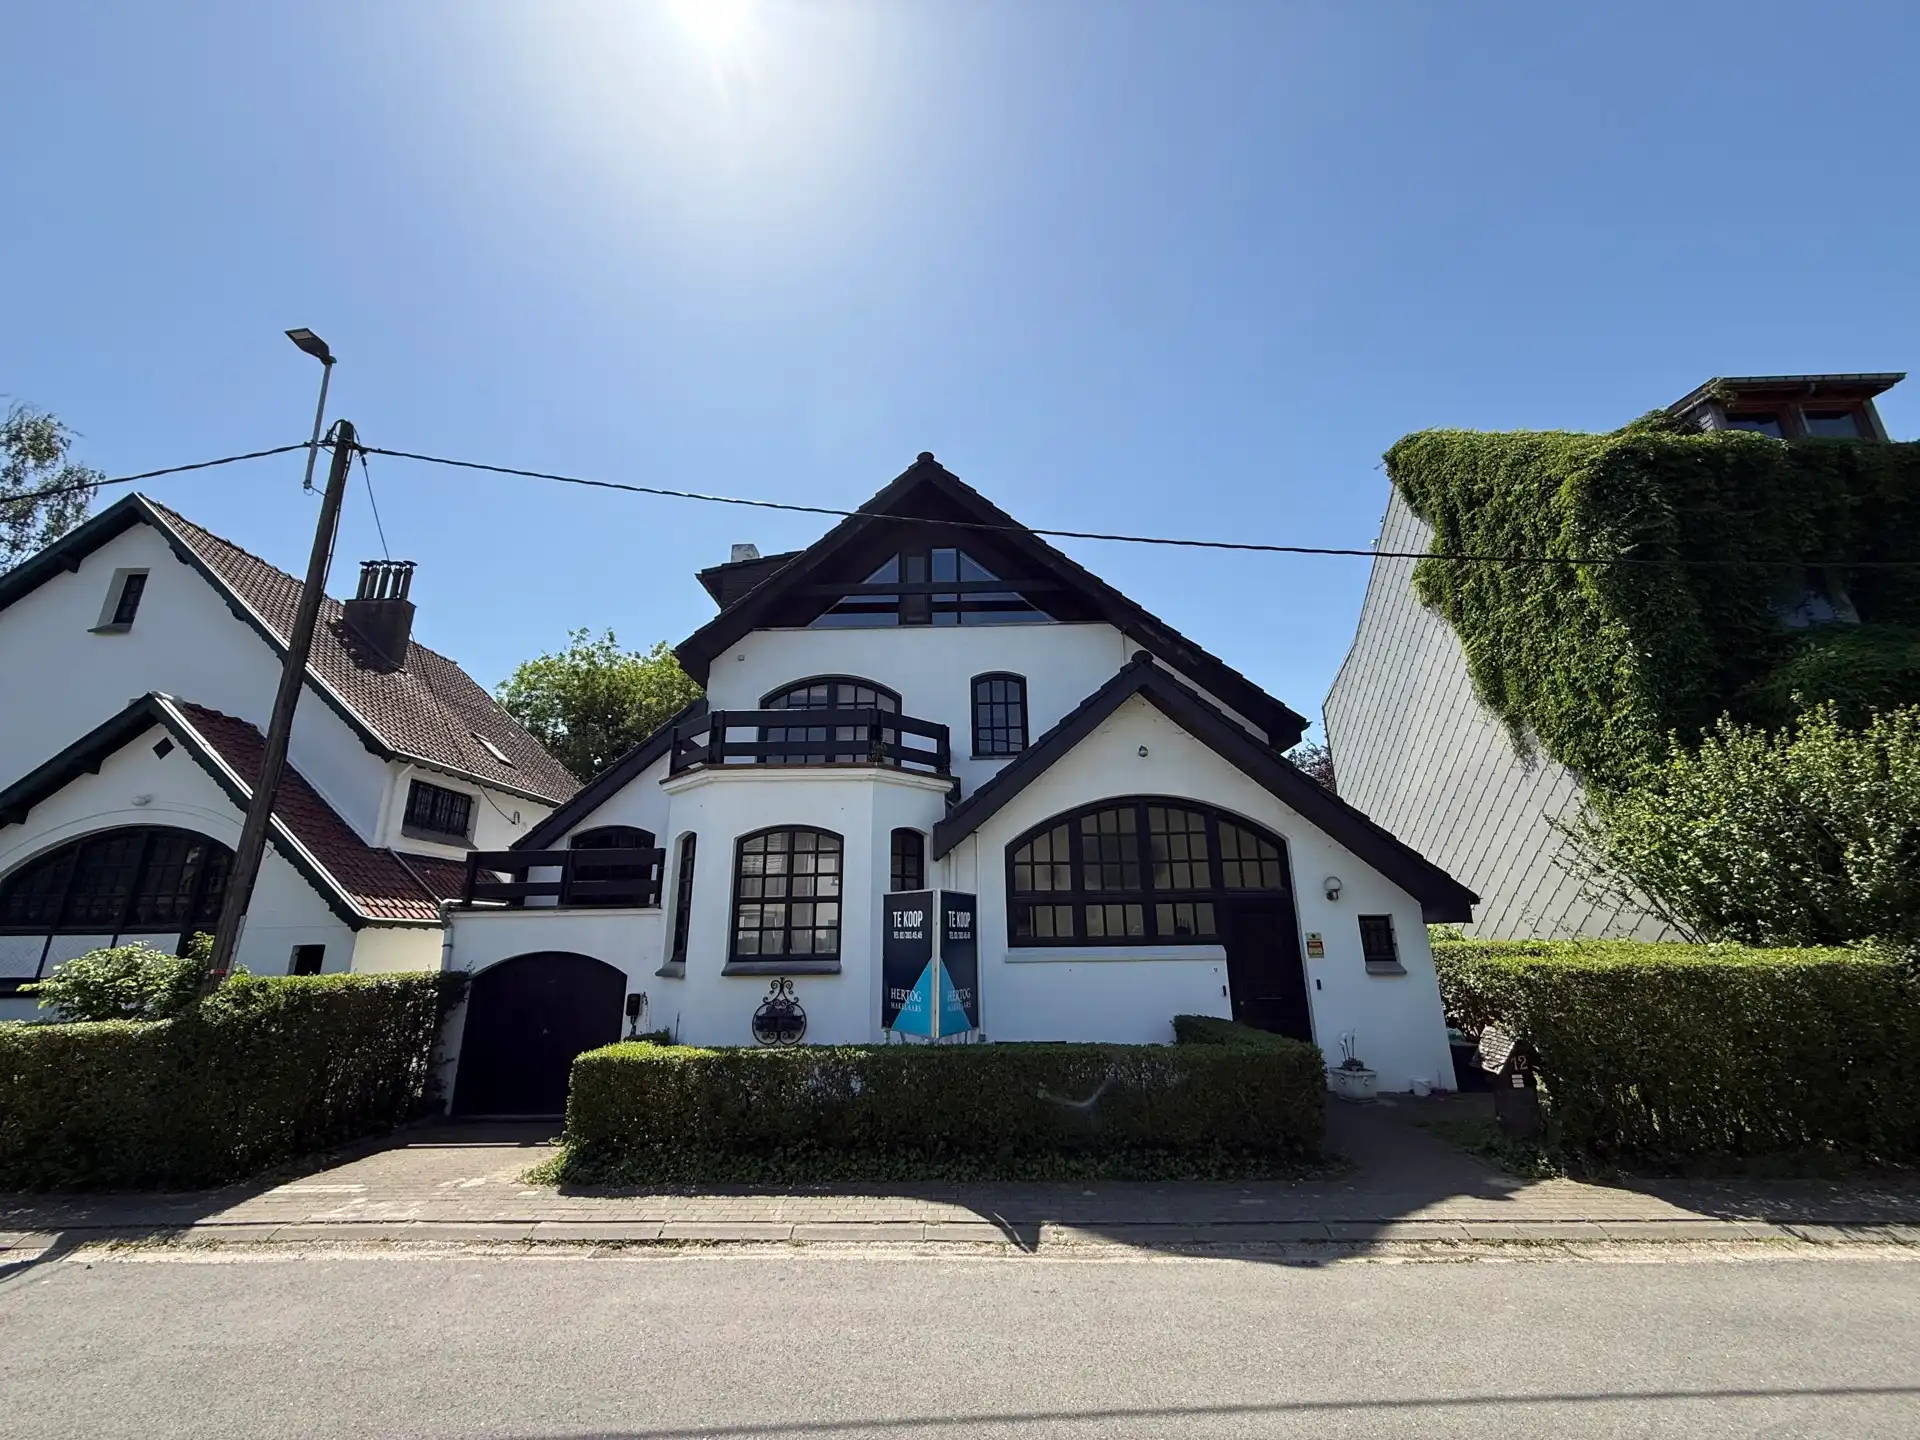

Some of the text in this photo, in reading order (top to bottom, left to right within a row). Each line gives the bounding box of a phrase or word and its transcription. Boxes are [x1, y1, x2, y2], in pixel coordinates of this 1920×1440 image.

[893, 910, 923, 928] TE KOOP
[948, 911, 971, 928] TE KOOP
[891, 988, 922, 1004] HERTOG
[1511, 1055, 1528, 1071] 12
